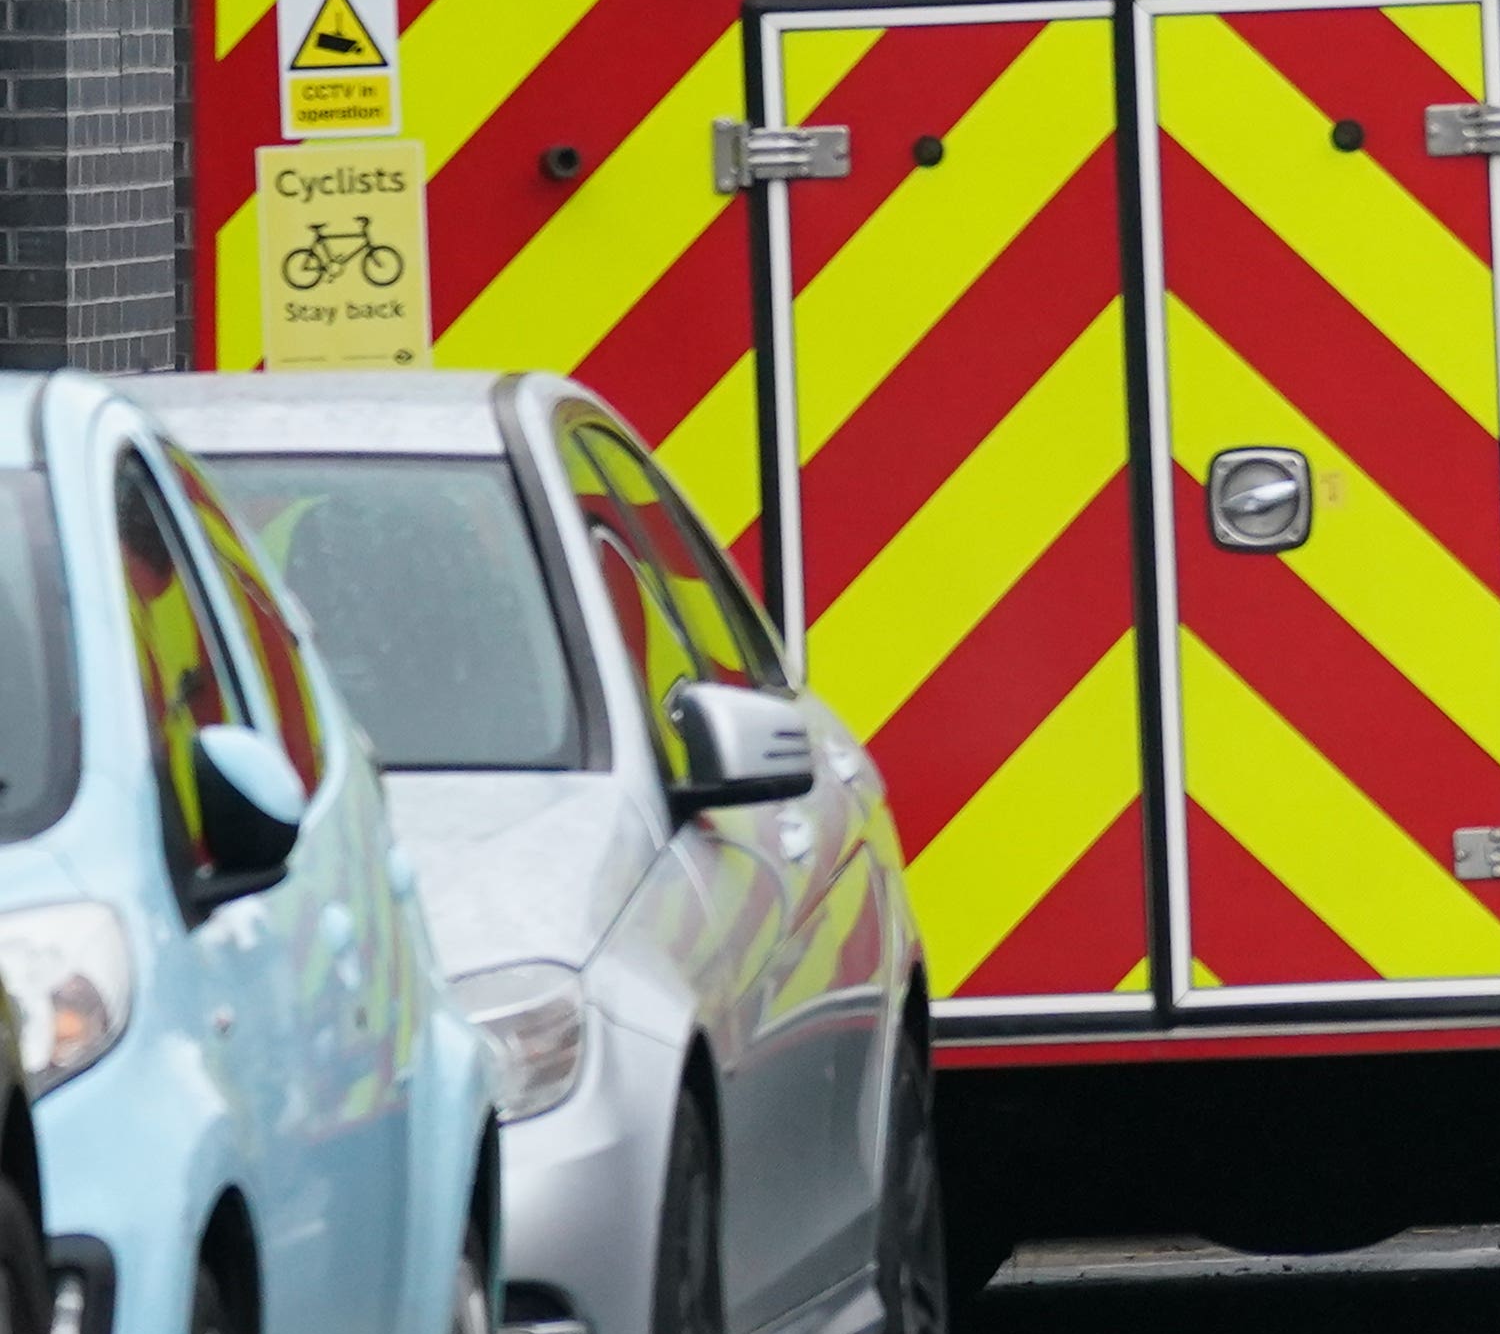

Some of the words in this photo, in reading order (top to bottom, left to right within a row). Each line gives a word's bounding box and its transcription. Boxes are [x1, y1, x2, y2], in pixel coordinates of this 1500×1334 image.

[301, 83, 355, 103] CCTV
[359, 82, 377, 100] in
[297, 103, 385, 125] operation
[274, 165, 408, 204] Cyclists
[284, 300, 337, 326] Stay
[345, 299, 407, 322] back
